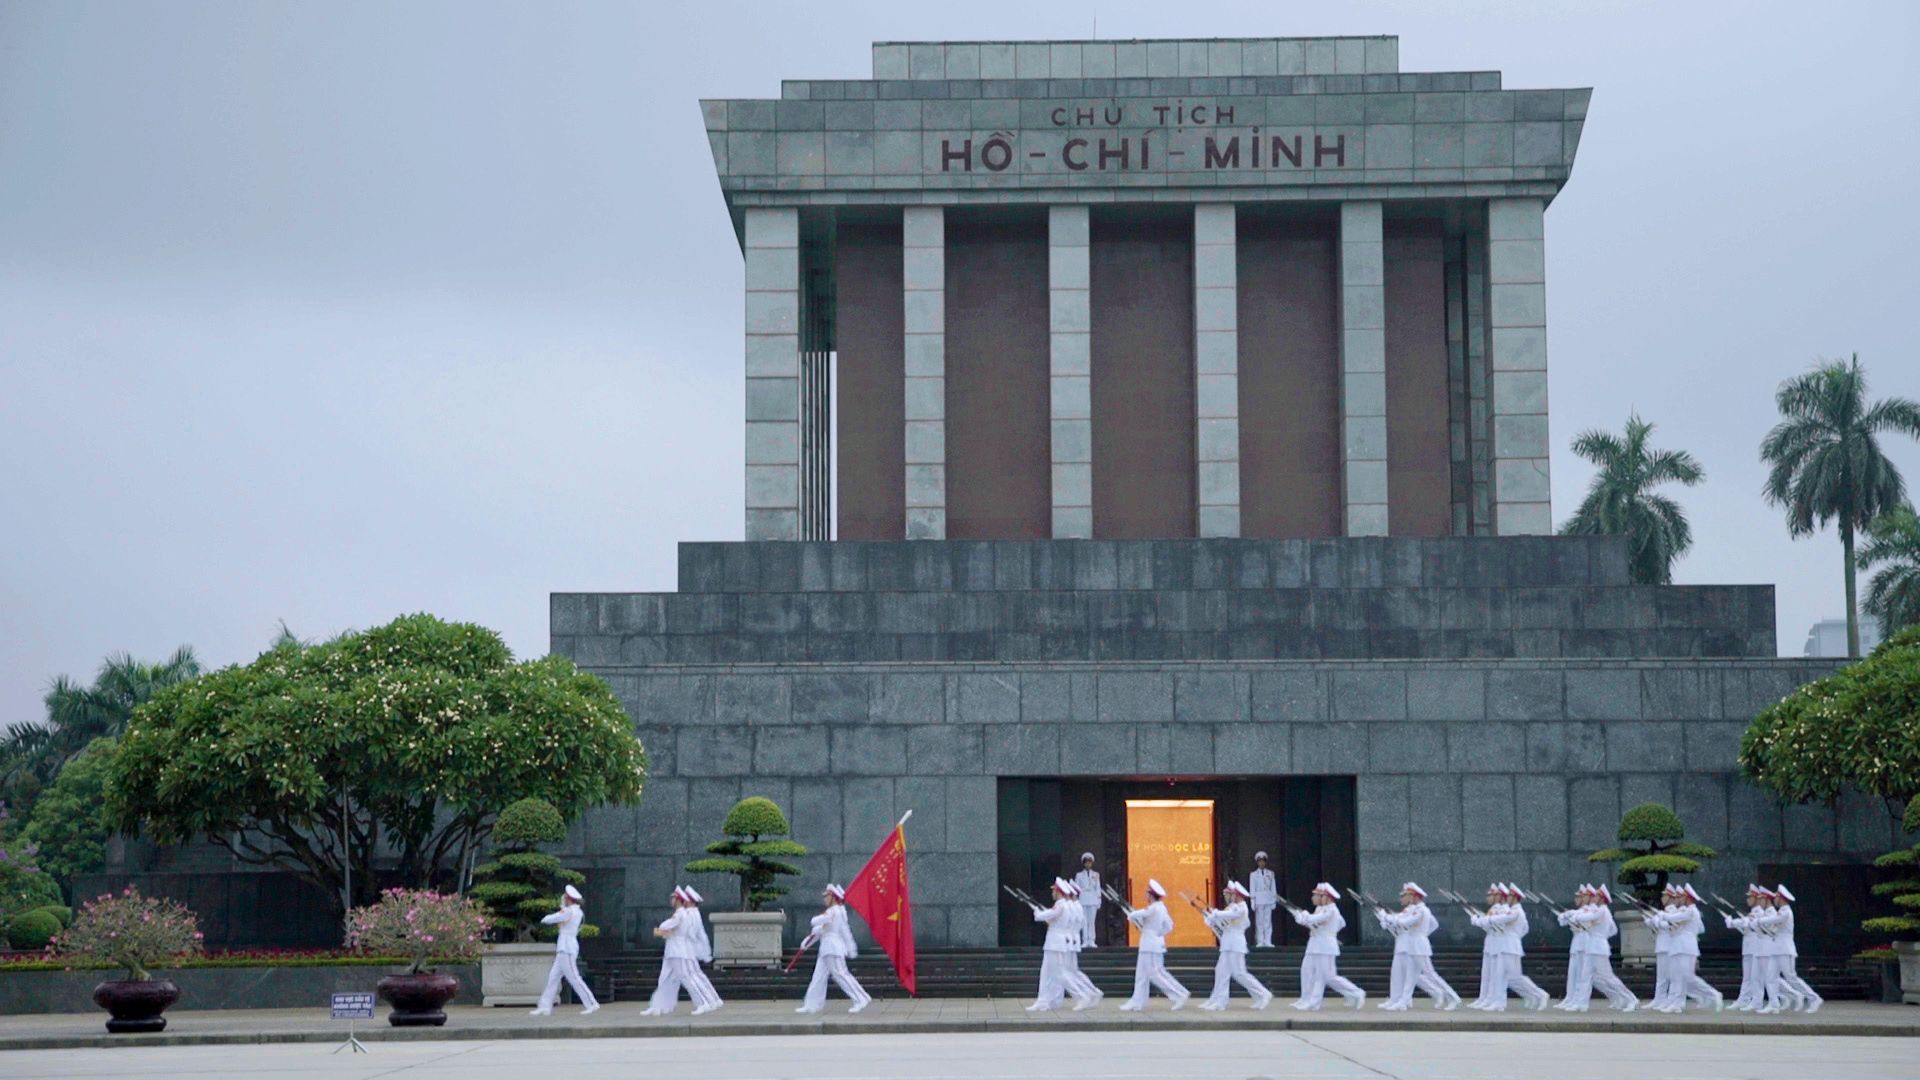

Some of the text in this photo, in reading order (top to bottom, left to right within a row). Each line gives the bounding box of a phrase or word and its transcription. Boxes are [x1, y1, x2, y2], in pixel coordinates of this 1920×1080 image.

[1051, 97, 1234, 133] CHỦ TỊCH
[942, 131, 1015, 172] HỒ
[1062, 128, 1156, 171] CHÍ
[1205, 126, 1345, 169] MINH
